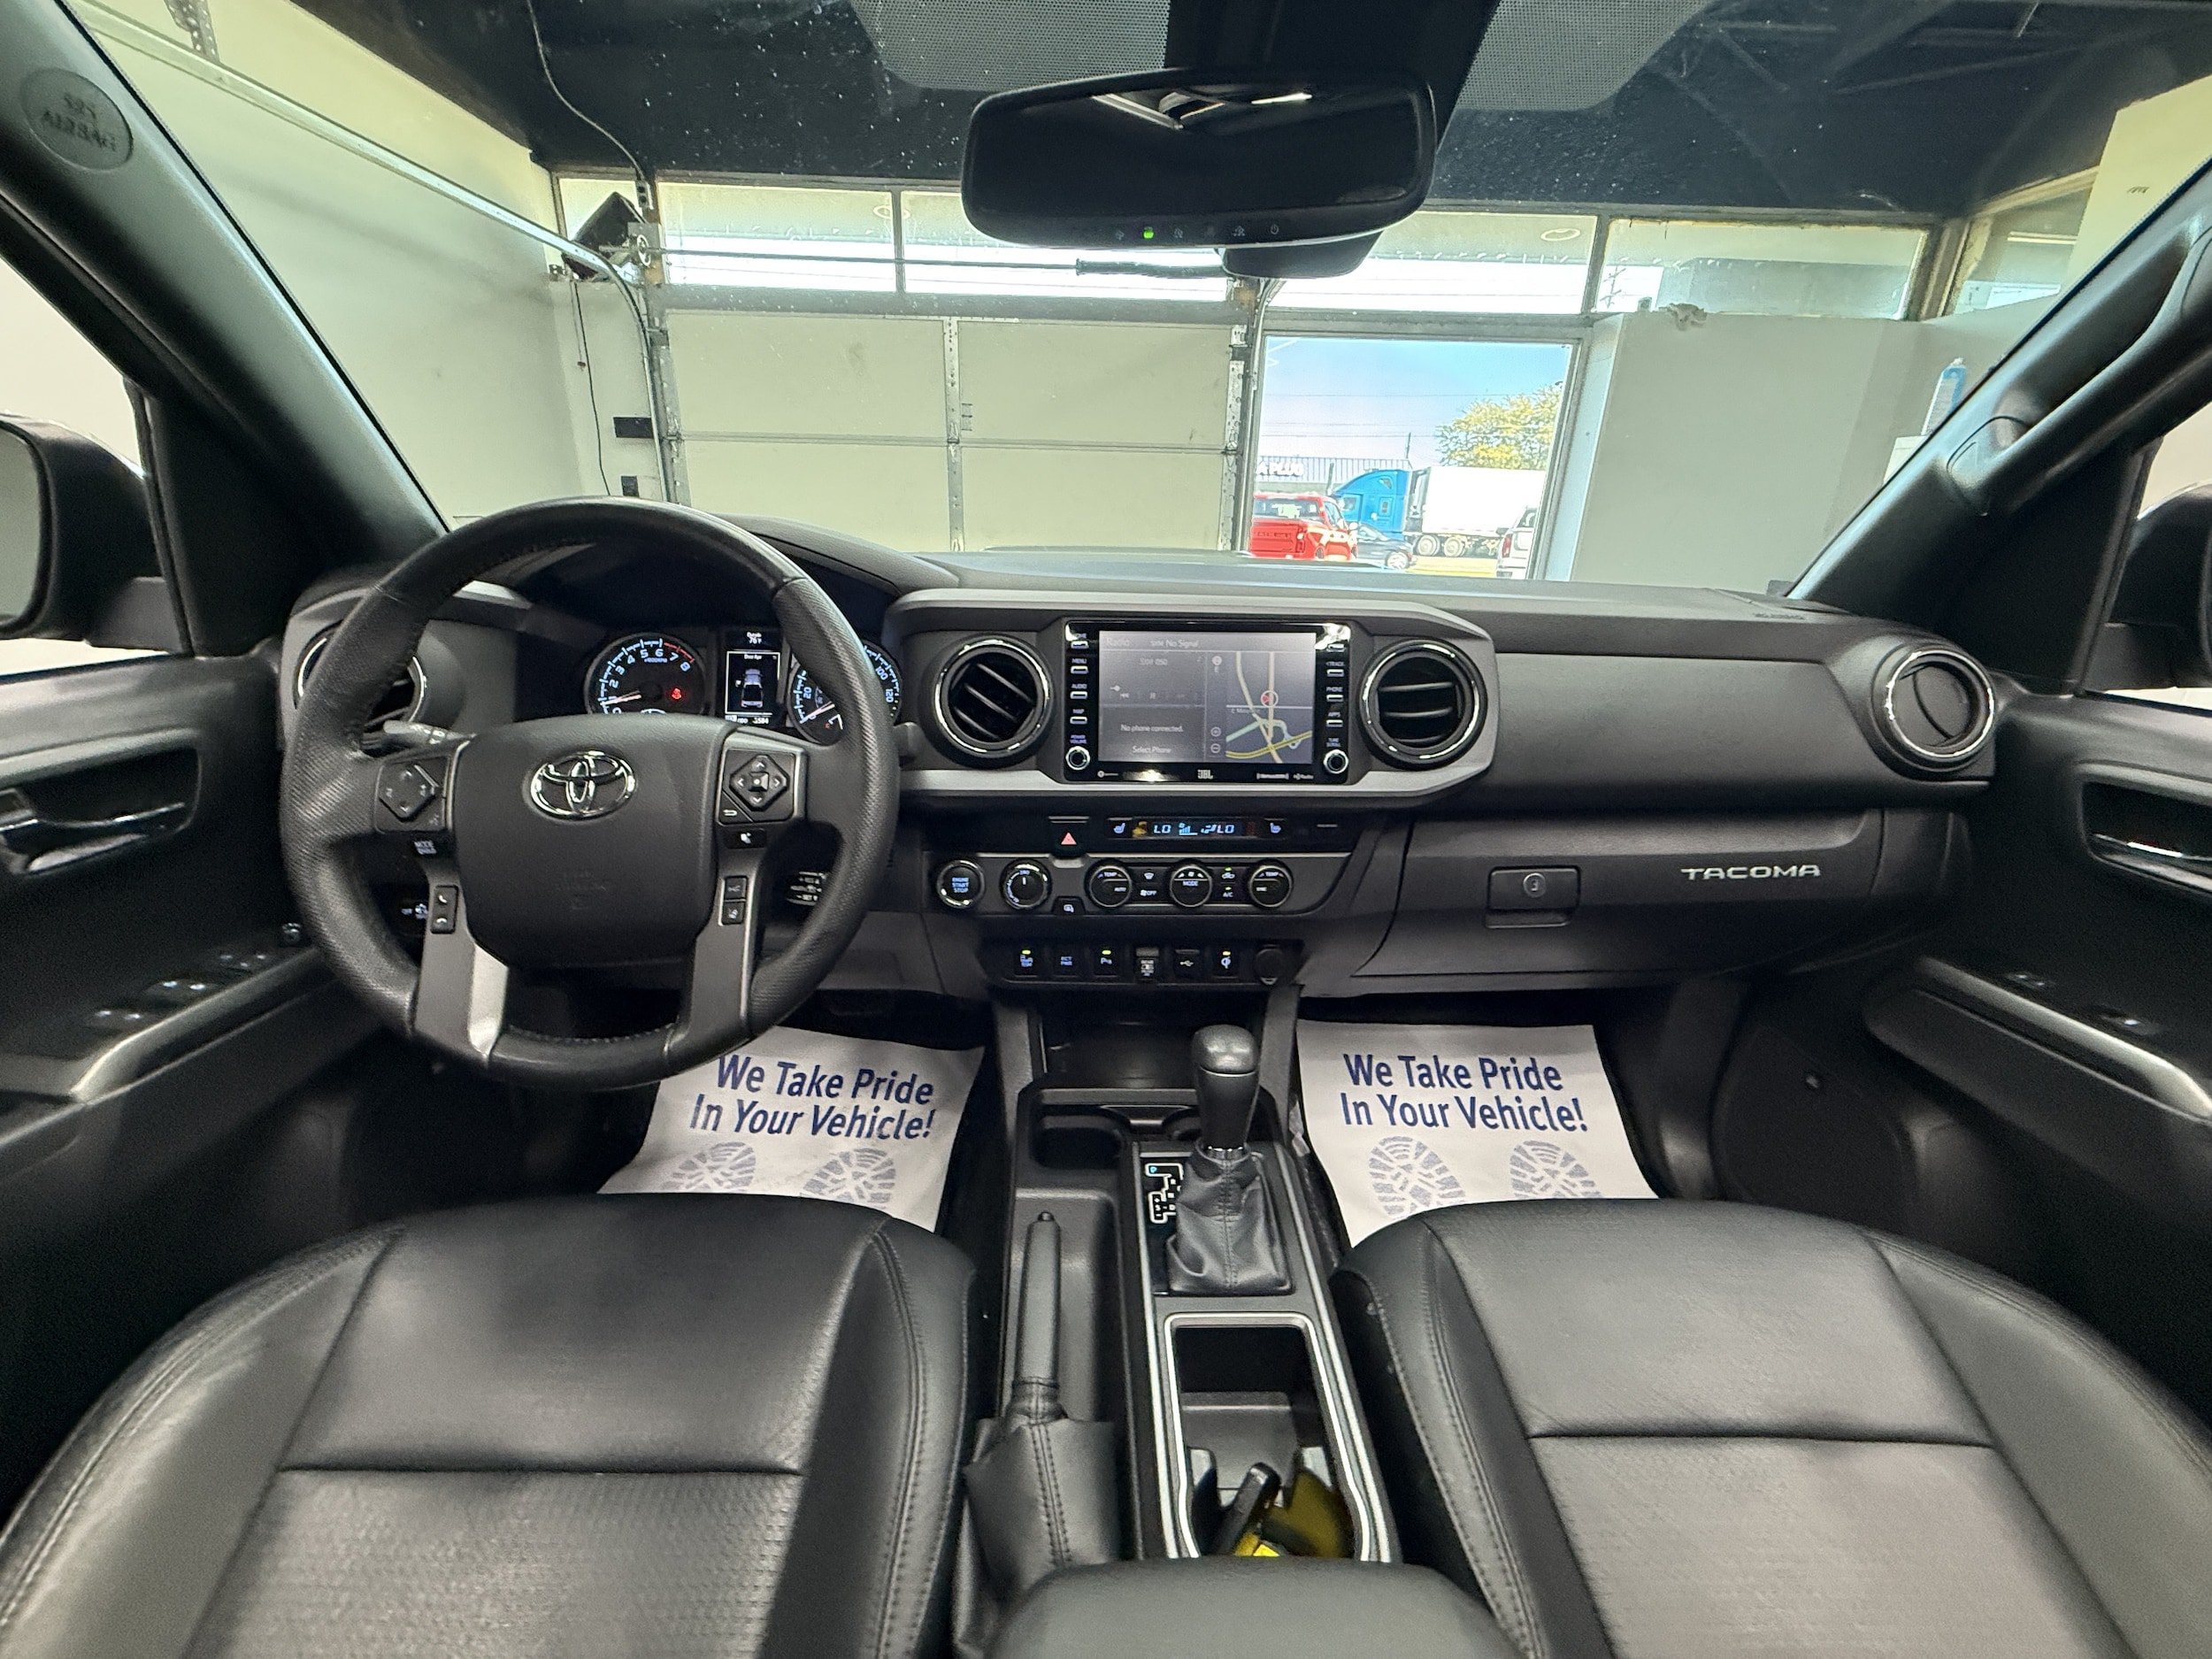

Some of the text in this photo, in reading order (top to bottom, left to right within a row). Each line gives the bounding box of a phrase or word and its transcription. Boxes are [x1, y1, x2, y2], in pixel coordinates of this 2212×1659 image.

[640, 649, 649, 658] 5
[670, 652, 679, 661] 7
[627, 655, 635, 664] 4
[615, 665, 625, 675] 3
[680, 661, 690, 672] 8
[876, 665, 888, 680] 100
[609, 680, 618, 688] 2
[803, 687, 811, 699] 20
[1197, 769, 1213, 780] JBL
[1153, 824, 1171, 833] LO
[1217, 824, 1235, 833] LO
[1681, 864, 1822, 881] TACOMA
[1343, 1053, 1563, 1092] We Take Pride
[718, 1054, 934, 1105] We Take Pride
[689, 1094, 936, 1141] In Your Vehicle!
[1340, 1092, 1589, 1133] In Your Vehicle!
